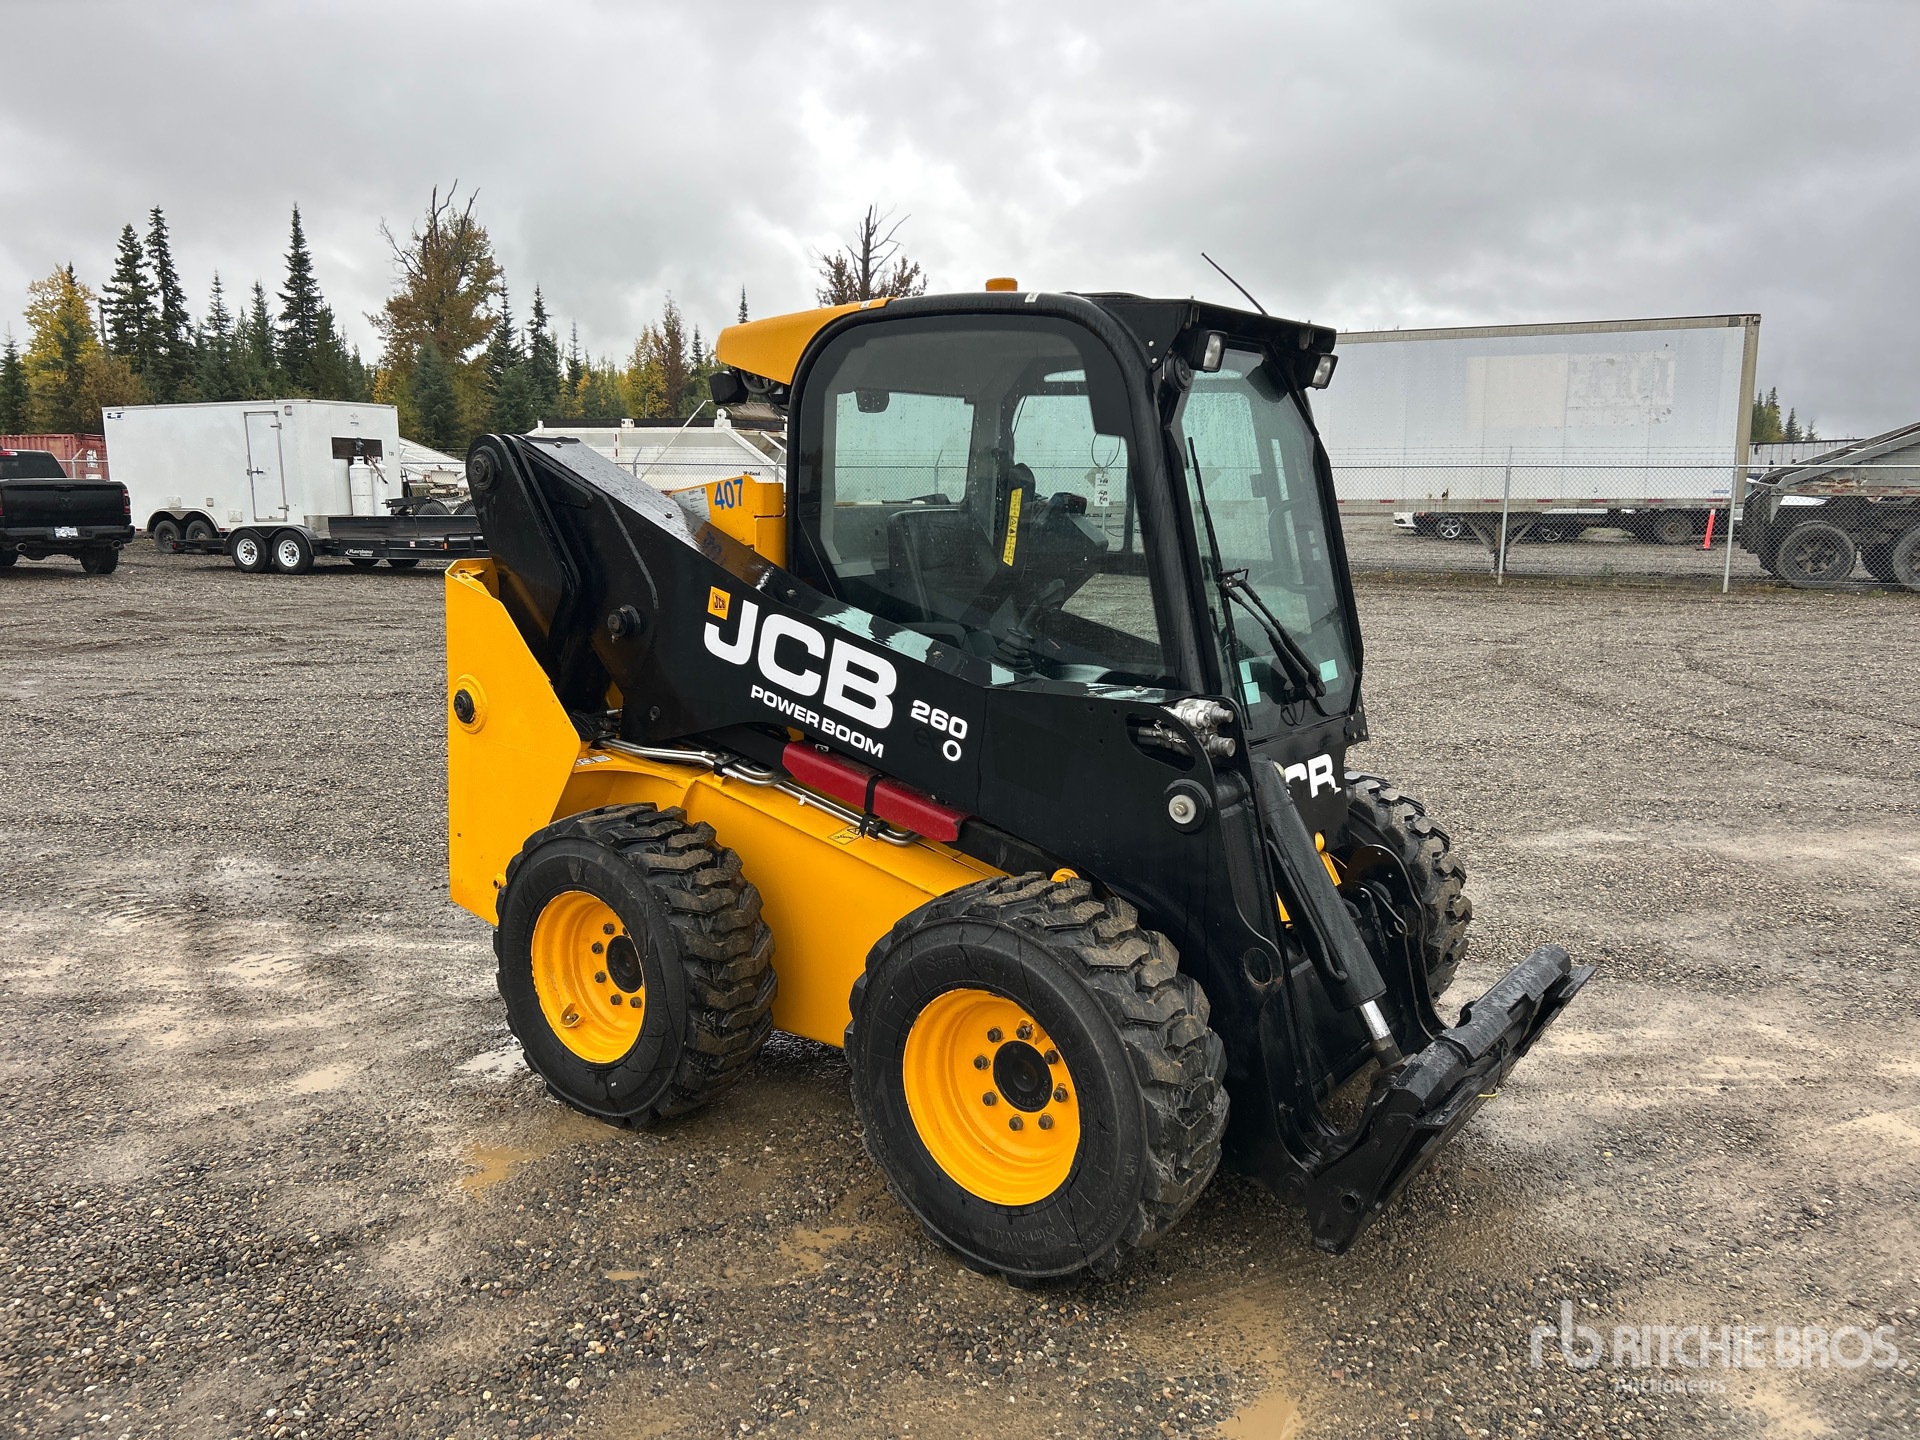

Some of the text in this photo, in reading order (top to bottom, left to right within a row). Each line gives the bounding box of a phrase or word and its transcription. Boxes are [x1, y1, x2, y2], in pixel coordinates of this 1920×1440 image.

[714, 478, 744, 510] 407
[704, 600, 897, 729] JCB
[751, 684, 884, 759] POWER BOOM
[910, 699, 968, 740] 260
